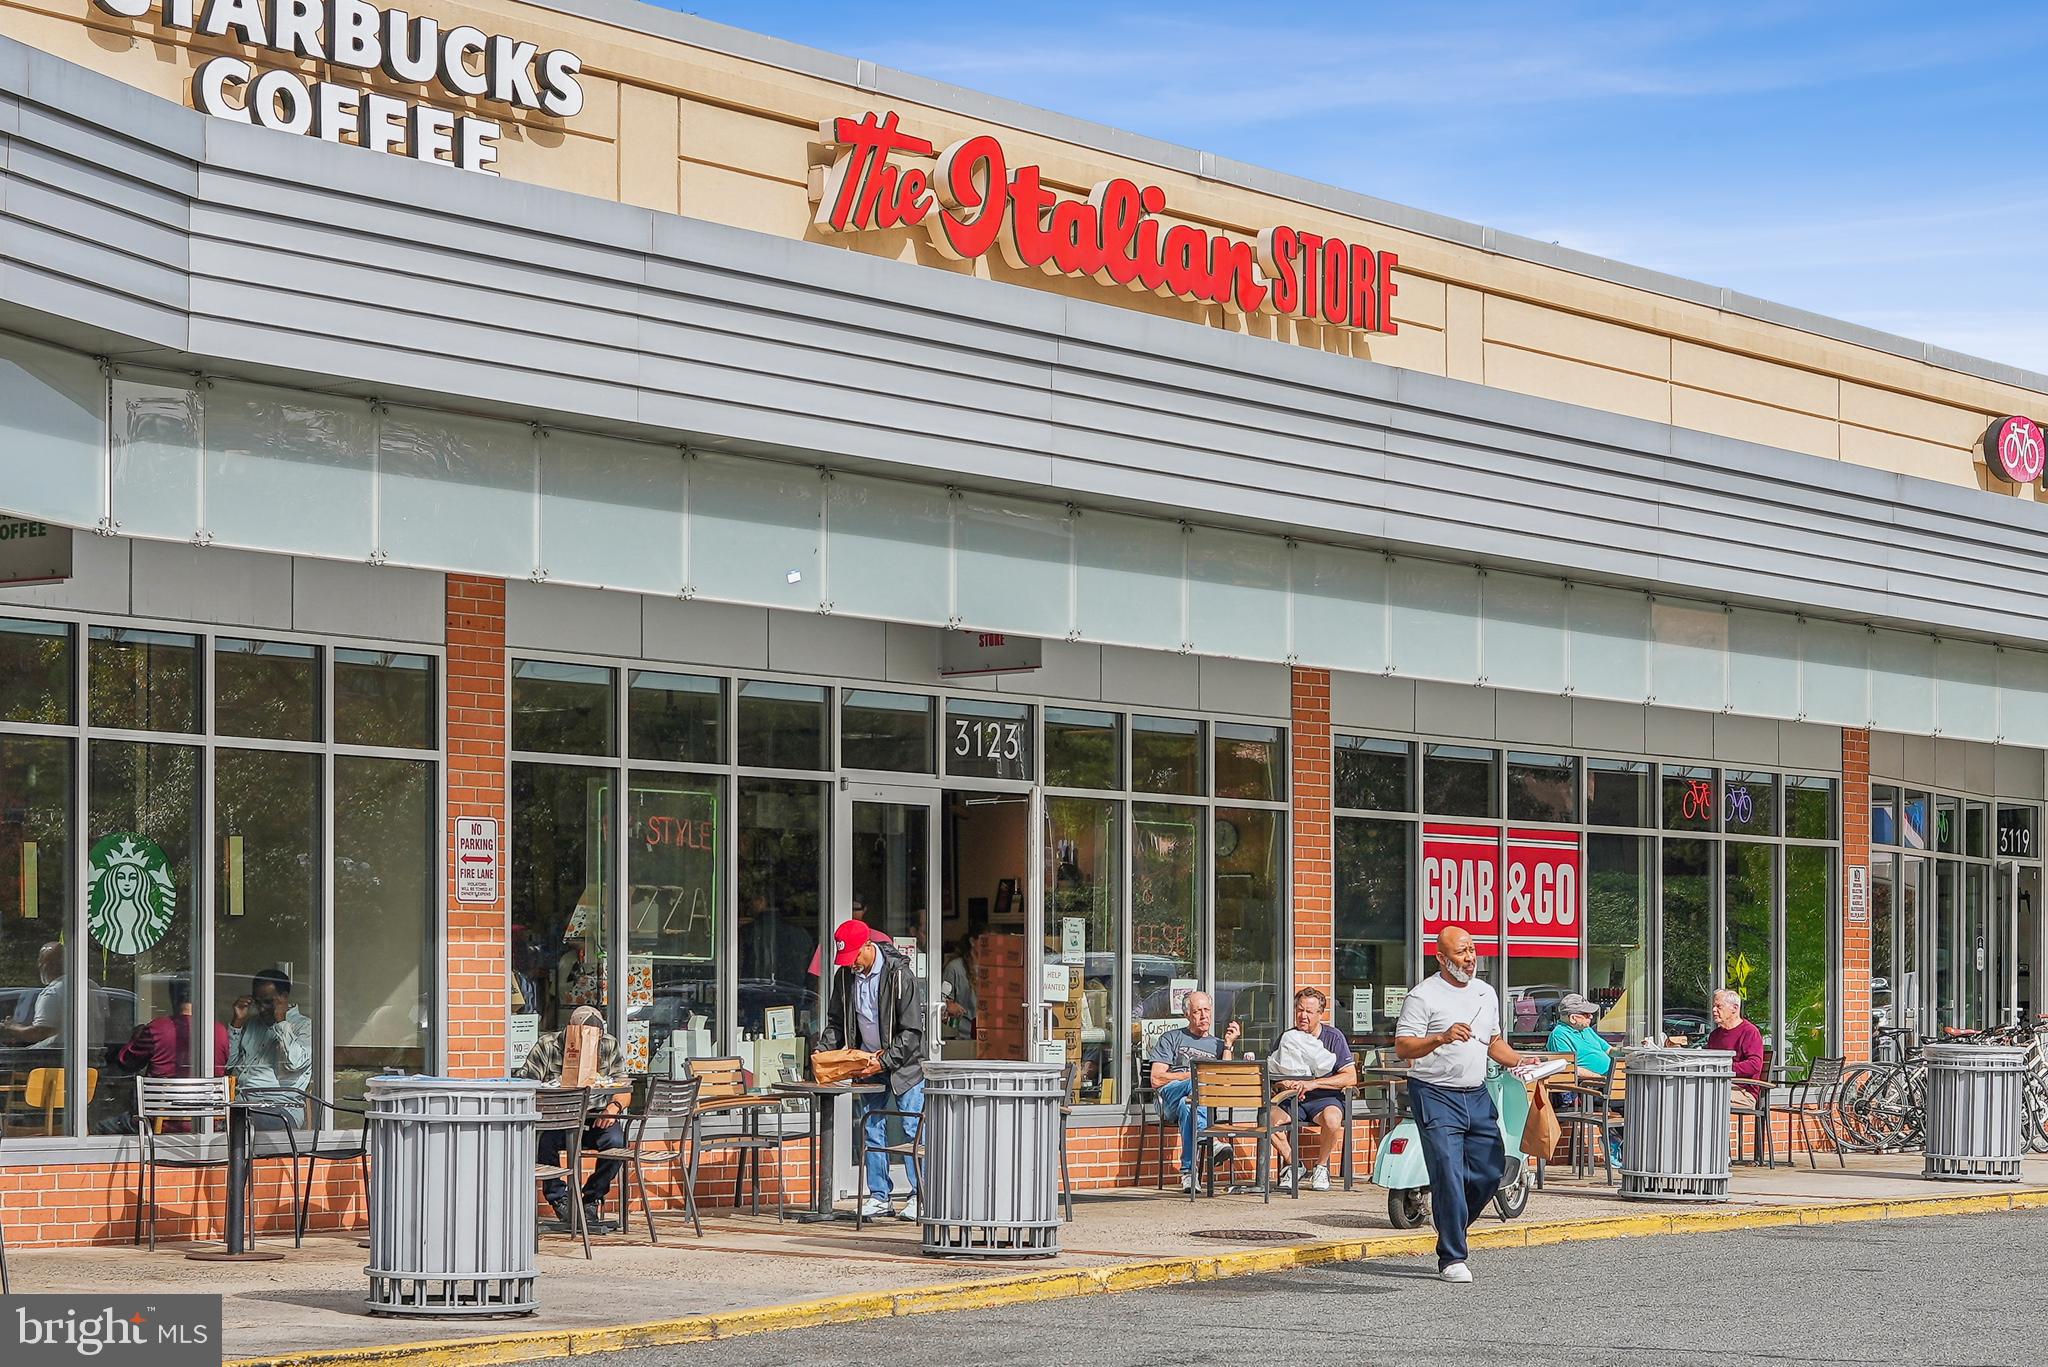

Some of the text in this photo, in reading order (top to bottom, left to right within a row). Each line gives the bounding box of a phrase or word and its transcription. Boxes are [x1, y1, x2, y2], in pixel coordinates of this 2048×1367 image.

[200, 55, 501, 178] COFFEE
[829, 110, 1400, 336] The Italian STORE
[954, 719, 1019, 760] 3123
[471, 823, 482, 836] NO
[646, 815, 712, 851] STYLE
[460, 838, 494, 851] PARKING
[2000, 827, 2030, 854] 3119
[460, 868, 494, 880] FIRE LANE
[1423, 856, 1495, 922] GRAB
[1046, 971, 1062, 979] HELP
[1042, 983, 1066, 992] WANTED
[513, 1043, 523, 1053] NO
